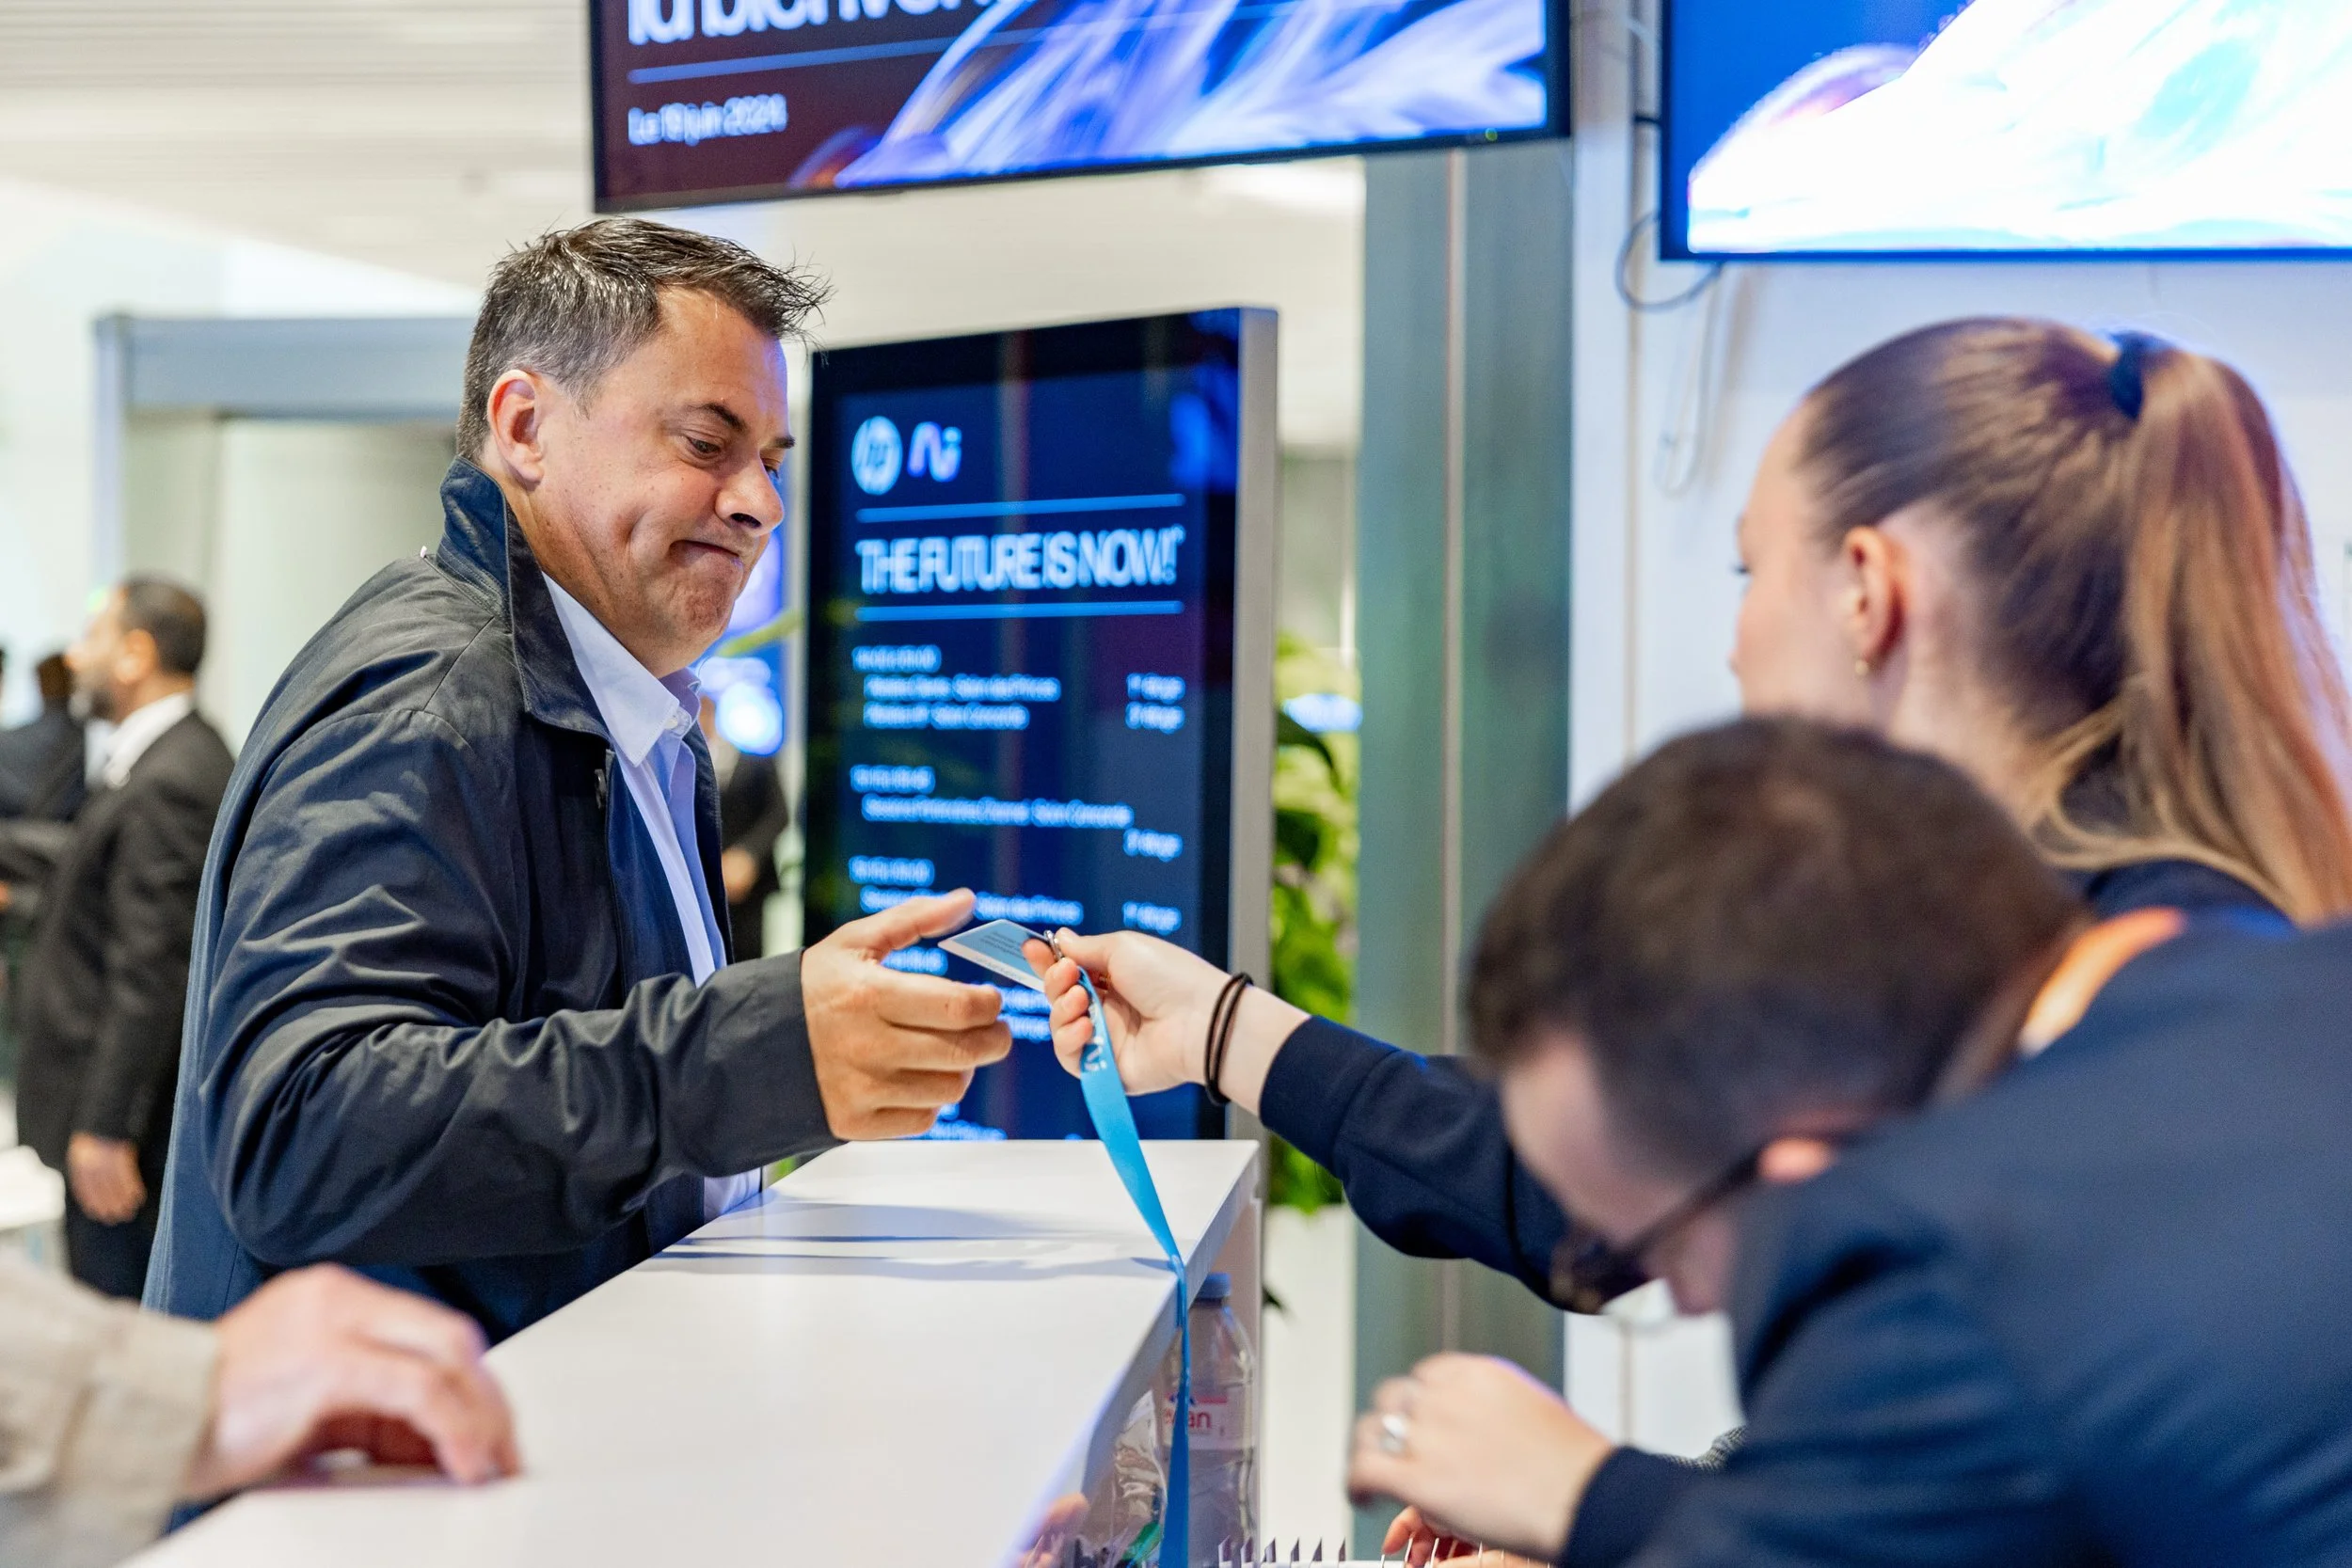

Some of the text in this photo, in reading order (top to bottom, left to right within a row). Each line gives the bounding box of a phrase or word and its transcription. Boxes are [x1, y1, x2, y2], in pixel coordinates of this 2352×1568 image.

[855, 539, 919, 594] THE
[920, 533, 1041, 593] FUTURE
[1042, 531, 1078, 589] IS
